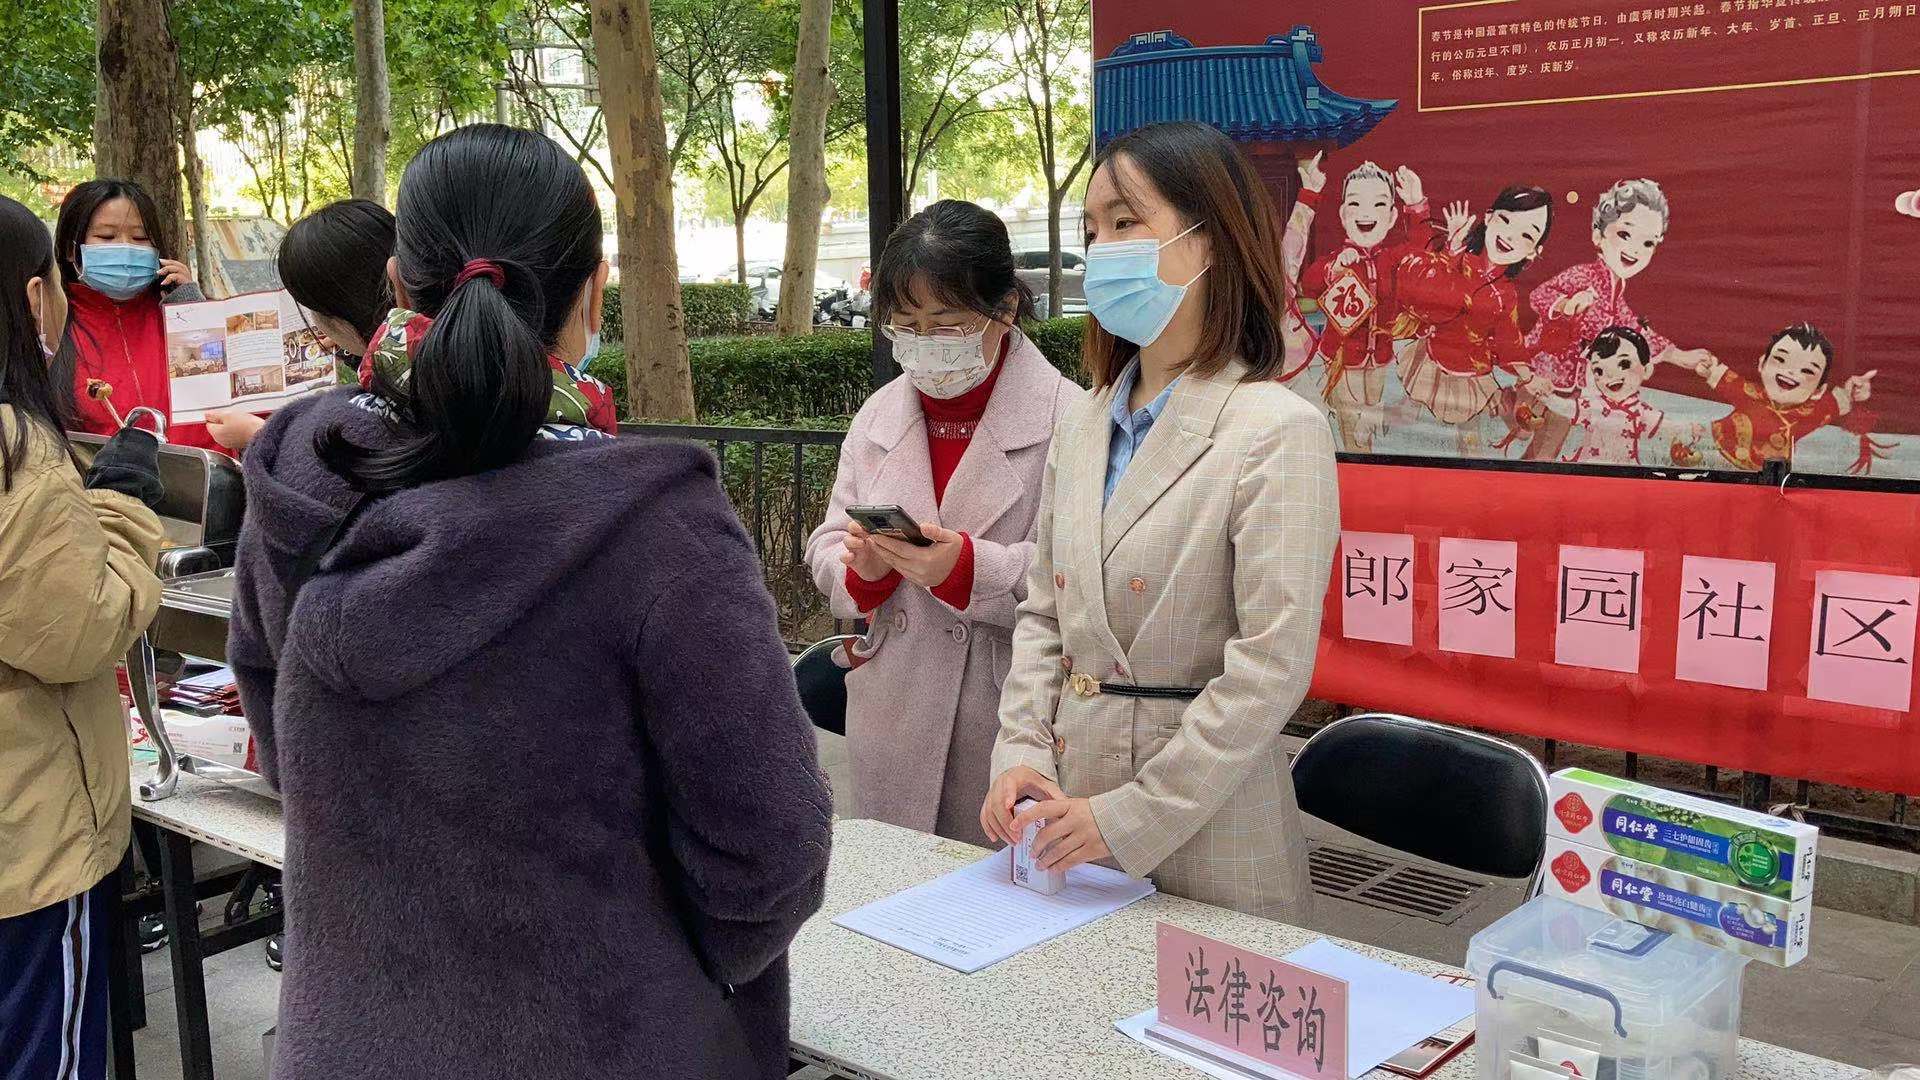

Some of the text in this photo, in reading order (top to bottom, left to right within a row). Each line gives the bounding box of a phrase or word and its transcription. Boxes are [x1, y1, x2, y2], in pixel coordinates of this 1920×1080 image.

[1332, 284, 1364, 318] 福
[1345, 548, 1912, 664] 郎家园社区
[1615, 815, 1658, 840] 同仁堂
[1611, 878, 1653, 902] 同仁堂
[1184, 946, 1326, 1073] 法律咨询
